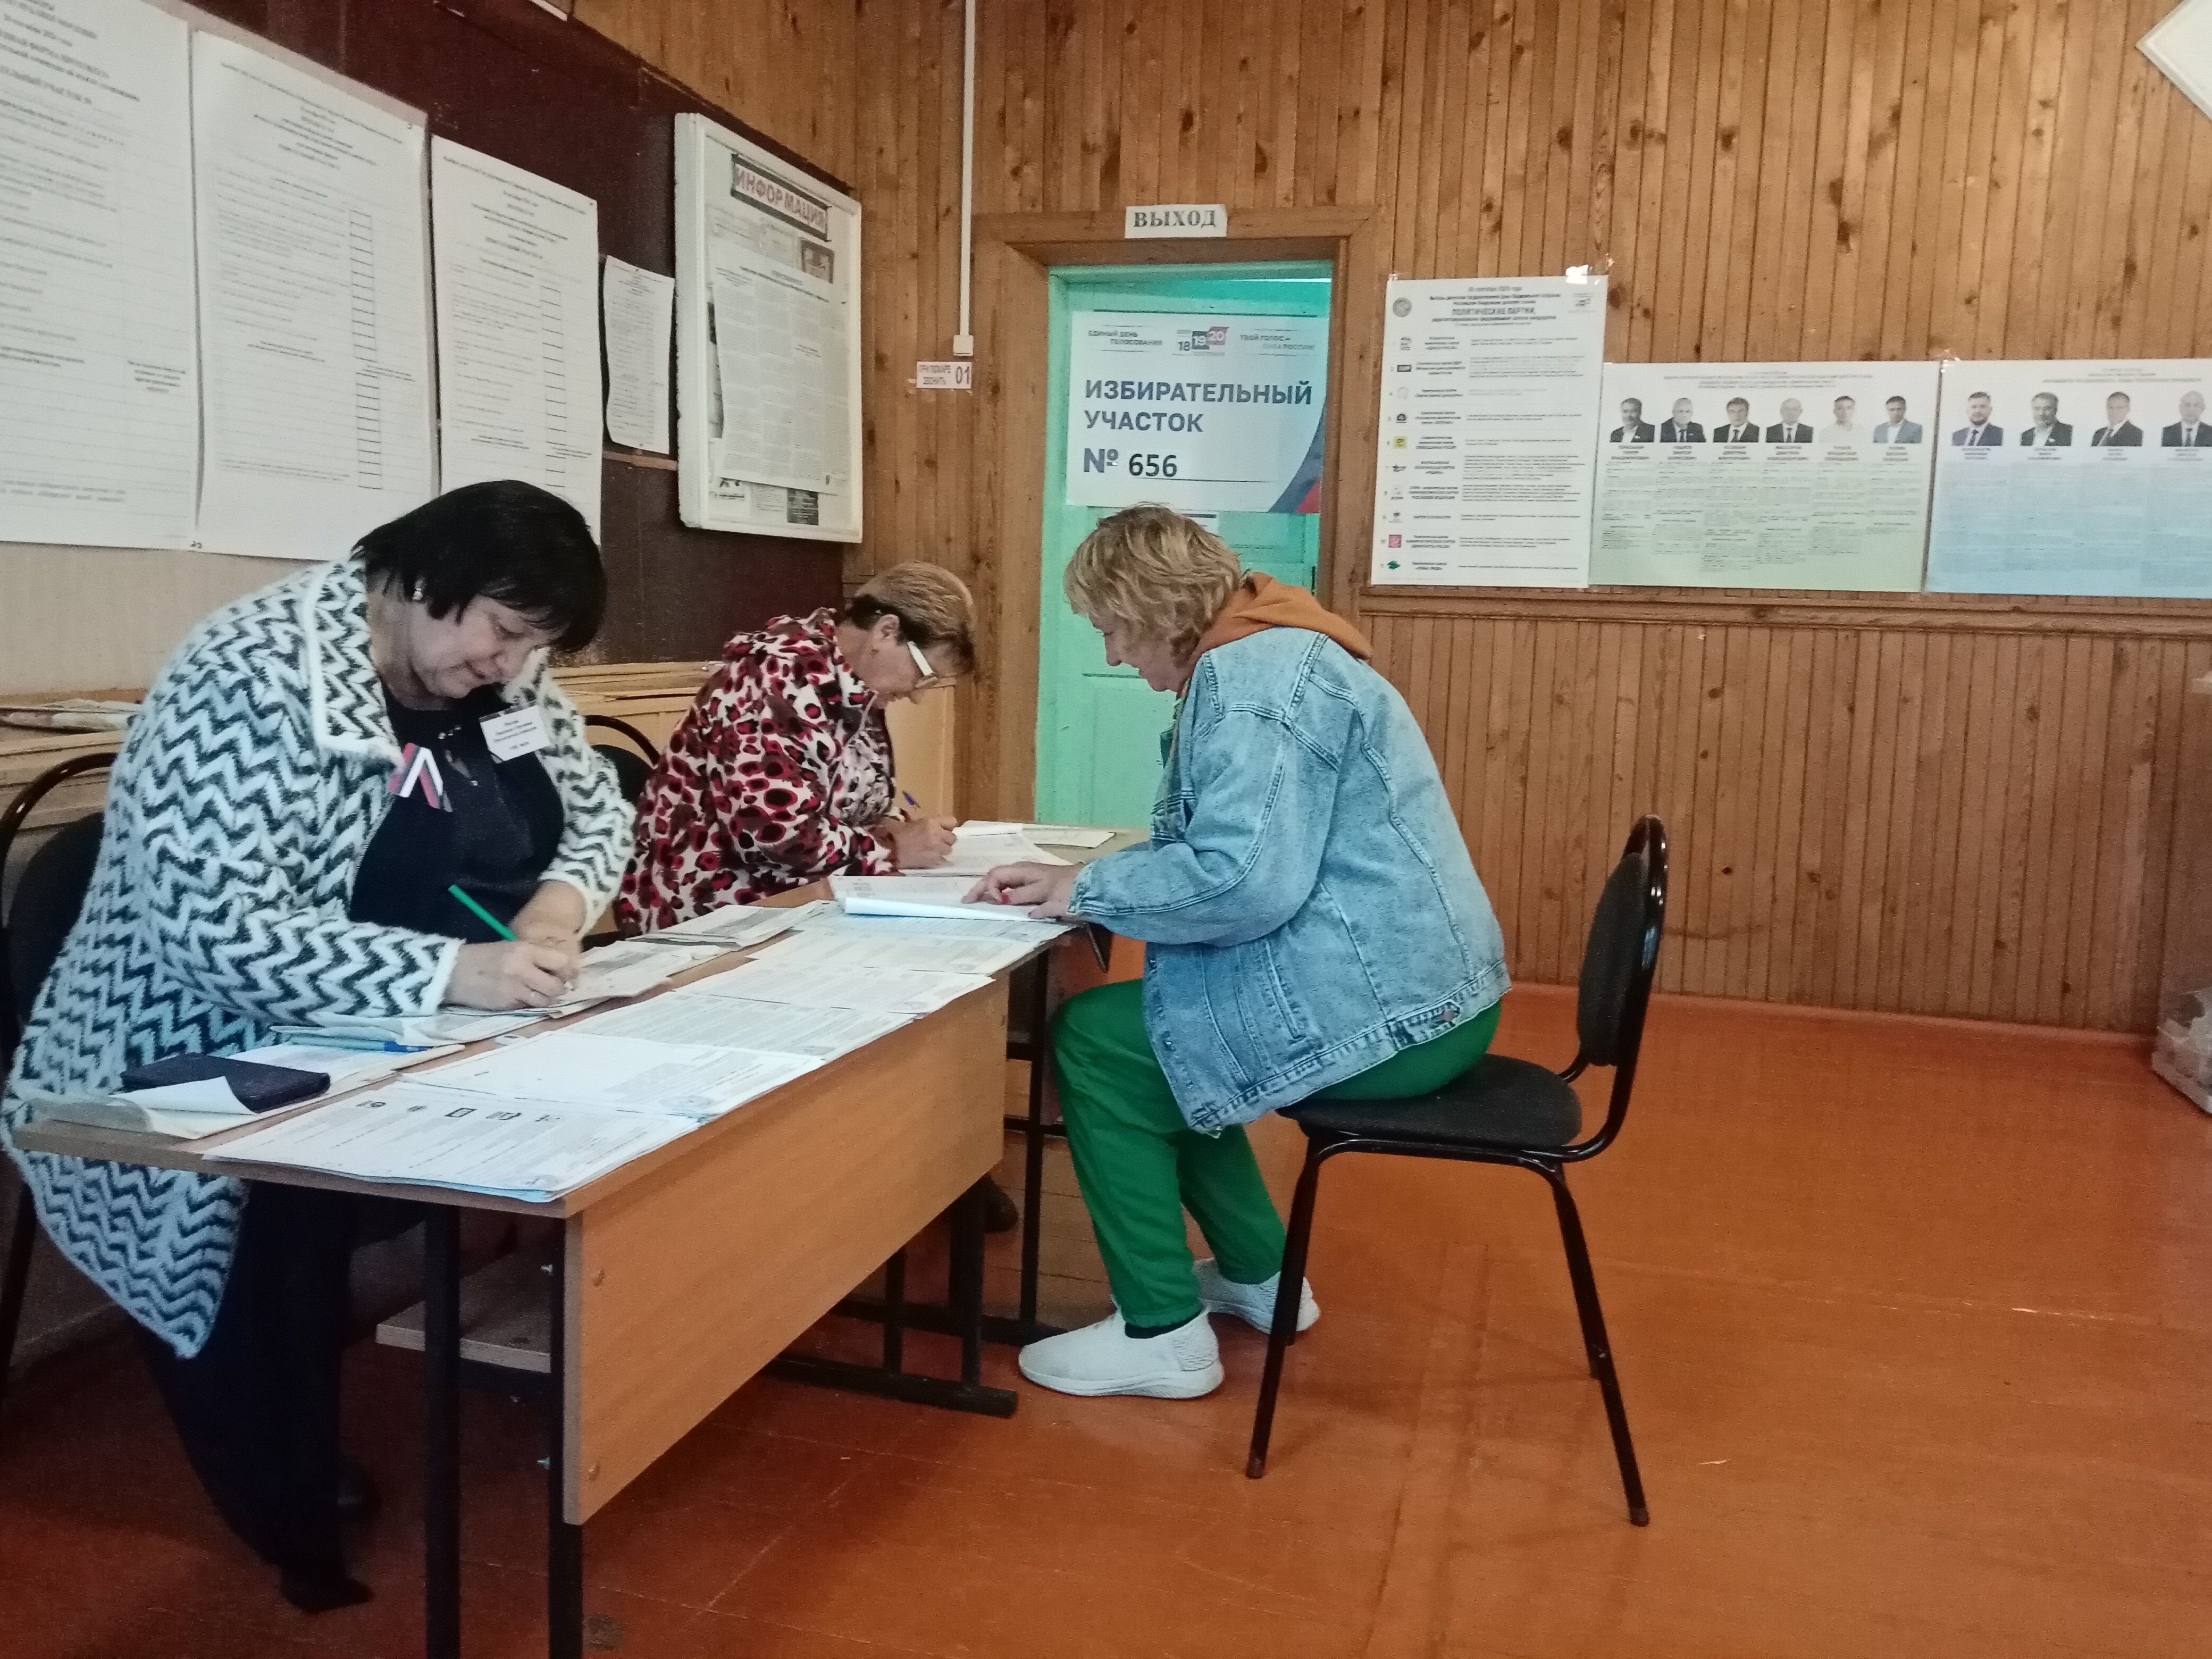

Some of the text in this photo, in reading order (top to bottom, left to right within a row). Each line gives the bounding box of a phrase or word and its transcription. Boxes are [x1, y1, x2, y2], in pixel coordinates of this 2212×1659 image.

[1133, 210, 1216, 229] ВЫХОД
[1178, 331, 1225, 351] 18 19 20
[956, 365, 970, 384] 01
[1085, 380, 1312, 405] ИЗБИРАТЕЛЬНЫЙ
[1084, 410, 1204, 432] УЧАСТОК
[1084, 448, 1178, 477] № 656
